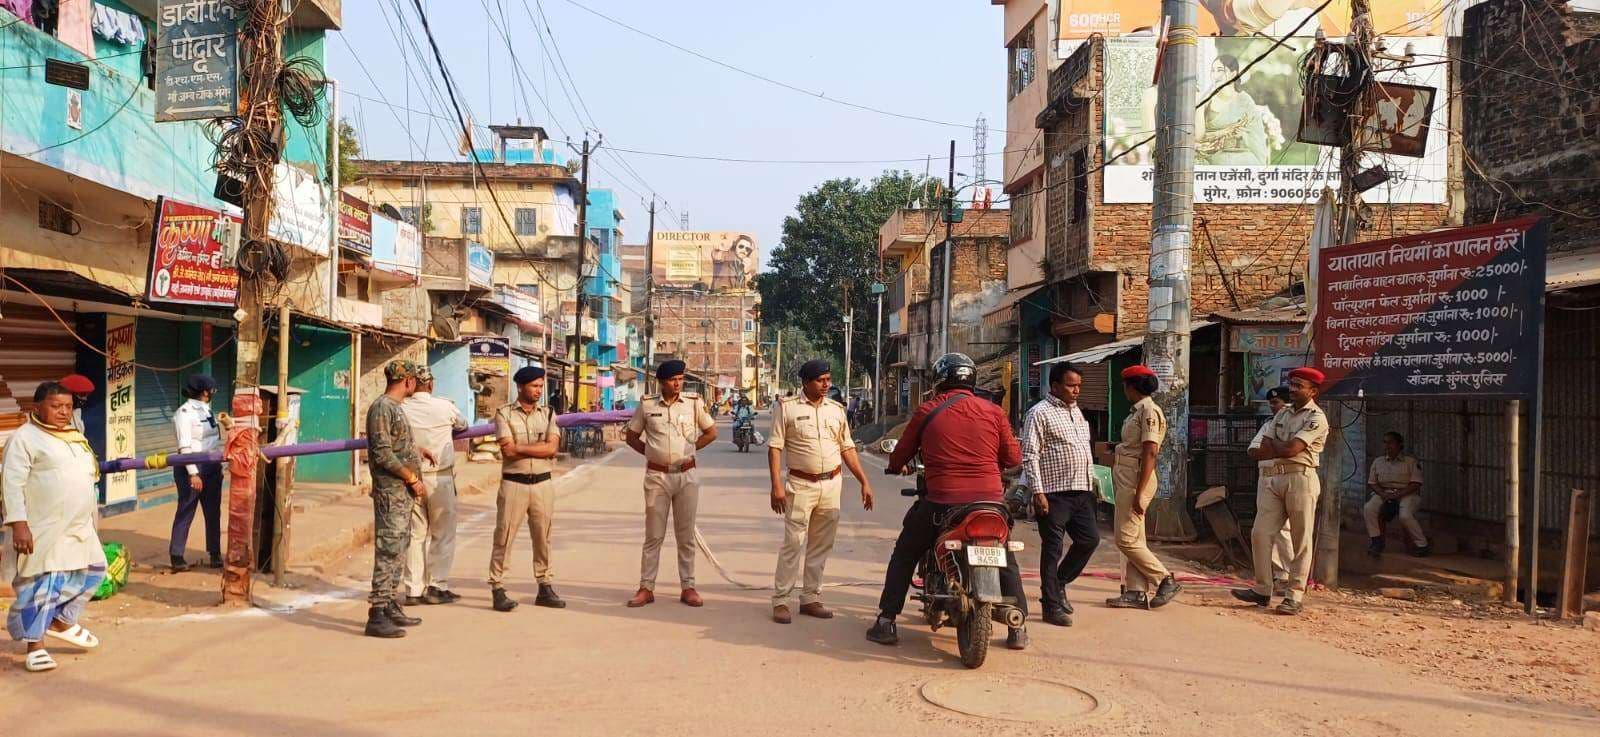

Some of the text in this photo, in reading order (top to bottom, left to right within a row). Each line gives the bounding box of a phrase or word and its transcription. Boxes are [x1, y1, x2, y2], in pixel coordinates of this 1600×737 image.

[1258, 168, 1279, 185] दुर्गा
[1282, 168, 1308, 181] मंदिर
[1203, 187, 1231, 202] मुंगेर,
[657, 232, 710, 242] DIRECTOR
[1328, 251, 1387, 271] यातायात
[1388, 241, 1433, 265] नियमों
[1432, 243, 1454, 259] का
[1453, 237, 1494, 257] पालन
[1373, 275, 1396, 288] वाहन
[1397, 272, 1426, 286] चालक
[1427, 264, 1460, 288] जुर्माना
[1401, 289, 1437, 310] जुर्माना
[1455, 288, 1489, 303] 1000
[1326, 316, 1348, 330] बिना
[1427, 304, 1459, 327] जुर्माना
[1394, 327, 1434, 349] जुर्माना
[1323, 353, 1341, 369] बिना
[1381, 356, 1403, 368] वाहन
[1432, 347, 1463, 369] जुर्माना
[1472, 369, 1508, 390] पुलिस
[110, 384, 132, 411] हॉल
